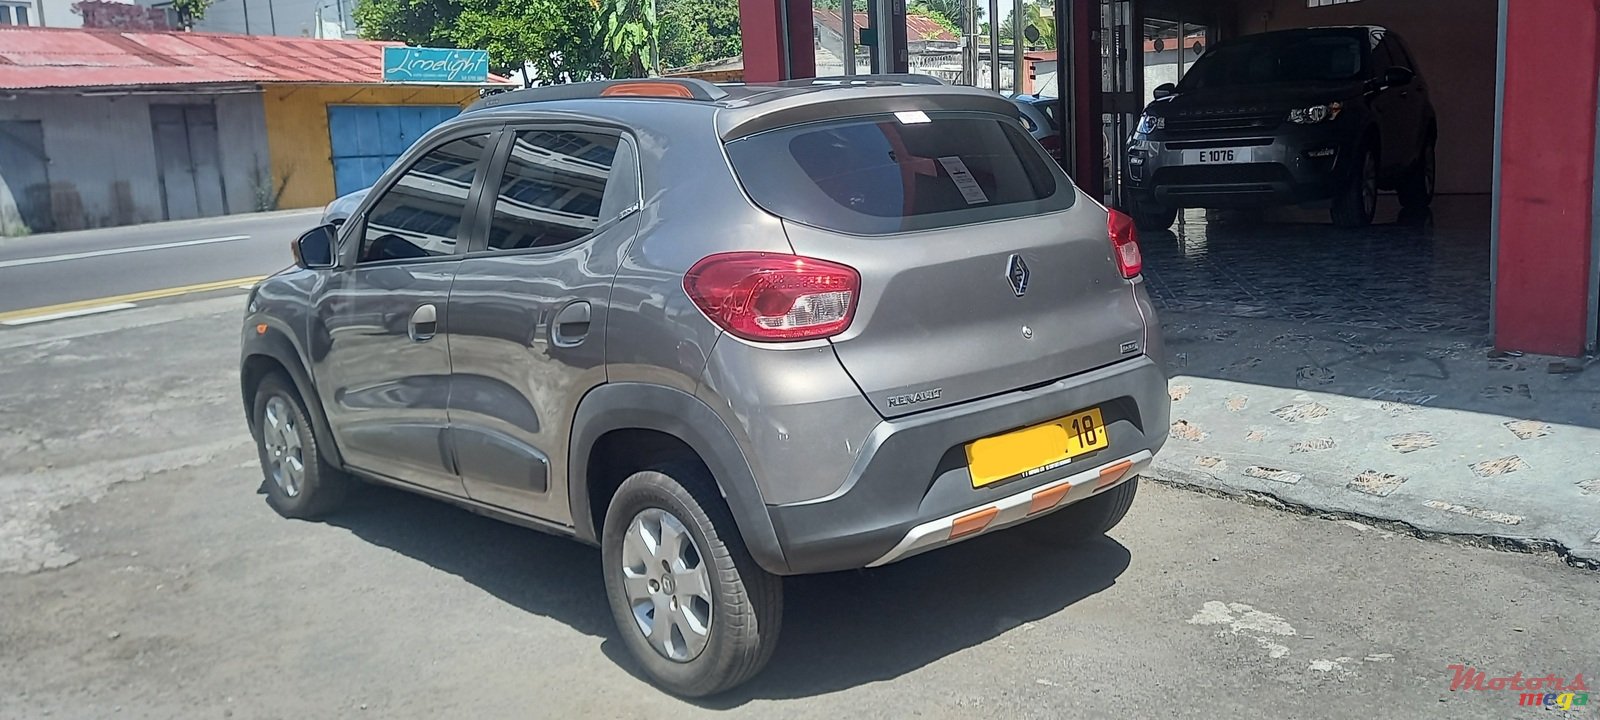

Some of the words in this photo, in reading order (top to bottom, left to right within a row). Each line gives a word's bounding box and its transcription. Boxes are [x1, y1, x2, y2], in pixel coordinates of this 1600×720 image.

[386, 50, 487, 80] Limelight
[1199, 151, 1207, 162] E
[1209, 150, 1234, 162] 1076
[887, 388, 942, 407] RENAULT
[1072, 415, 1097, 449] 18
